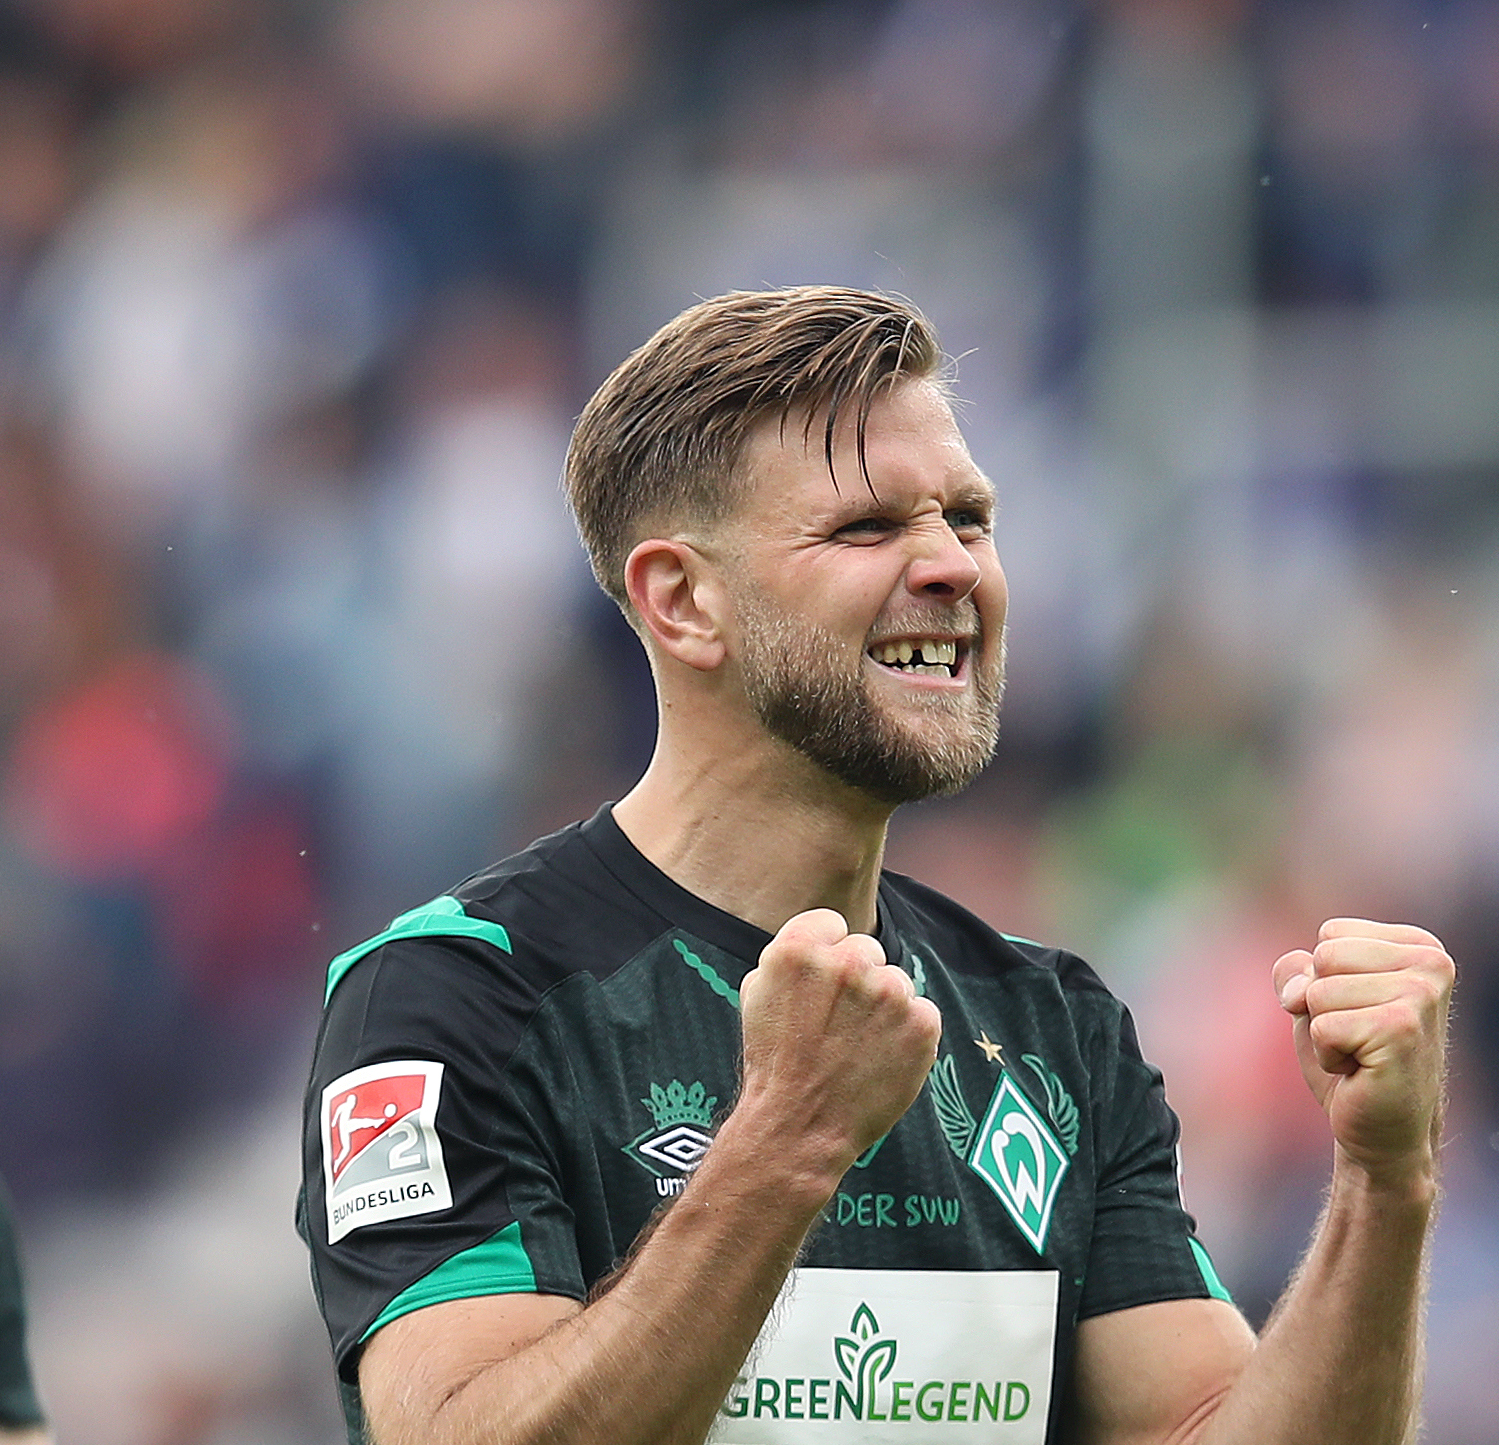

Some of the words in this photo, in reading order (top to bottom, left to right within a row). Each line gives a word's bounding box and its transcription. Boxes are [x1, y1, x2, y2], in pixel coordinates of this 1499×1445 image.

[388, 1121, 421, 1169] 2
[333, 1182, 435, 1225] BUNDESLIGA
[905, 1195, 960, 1227] SVW
